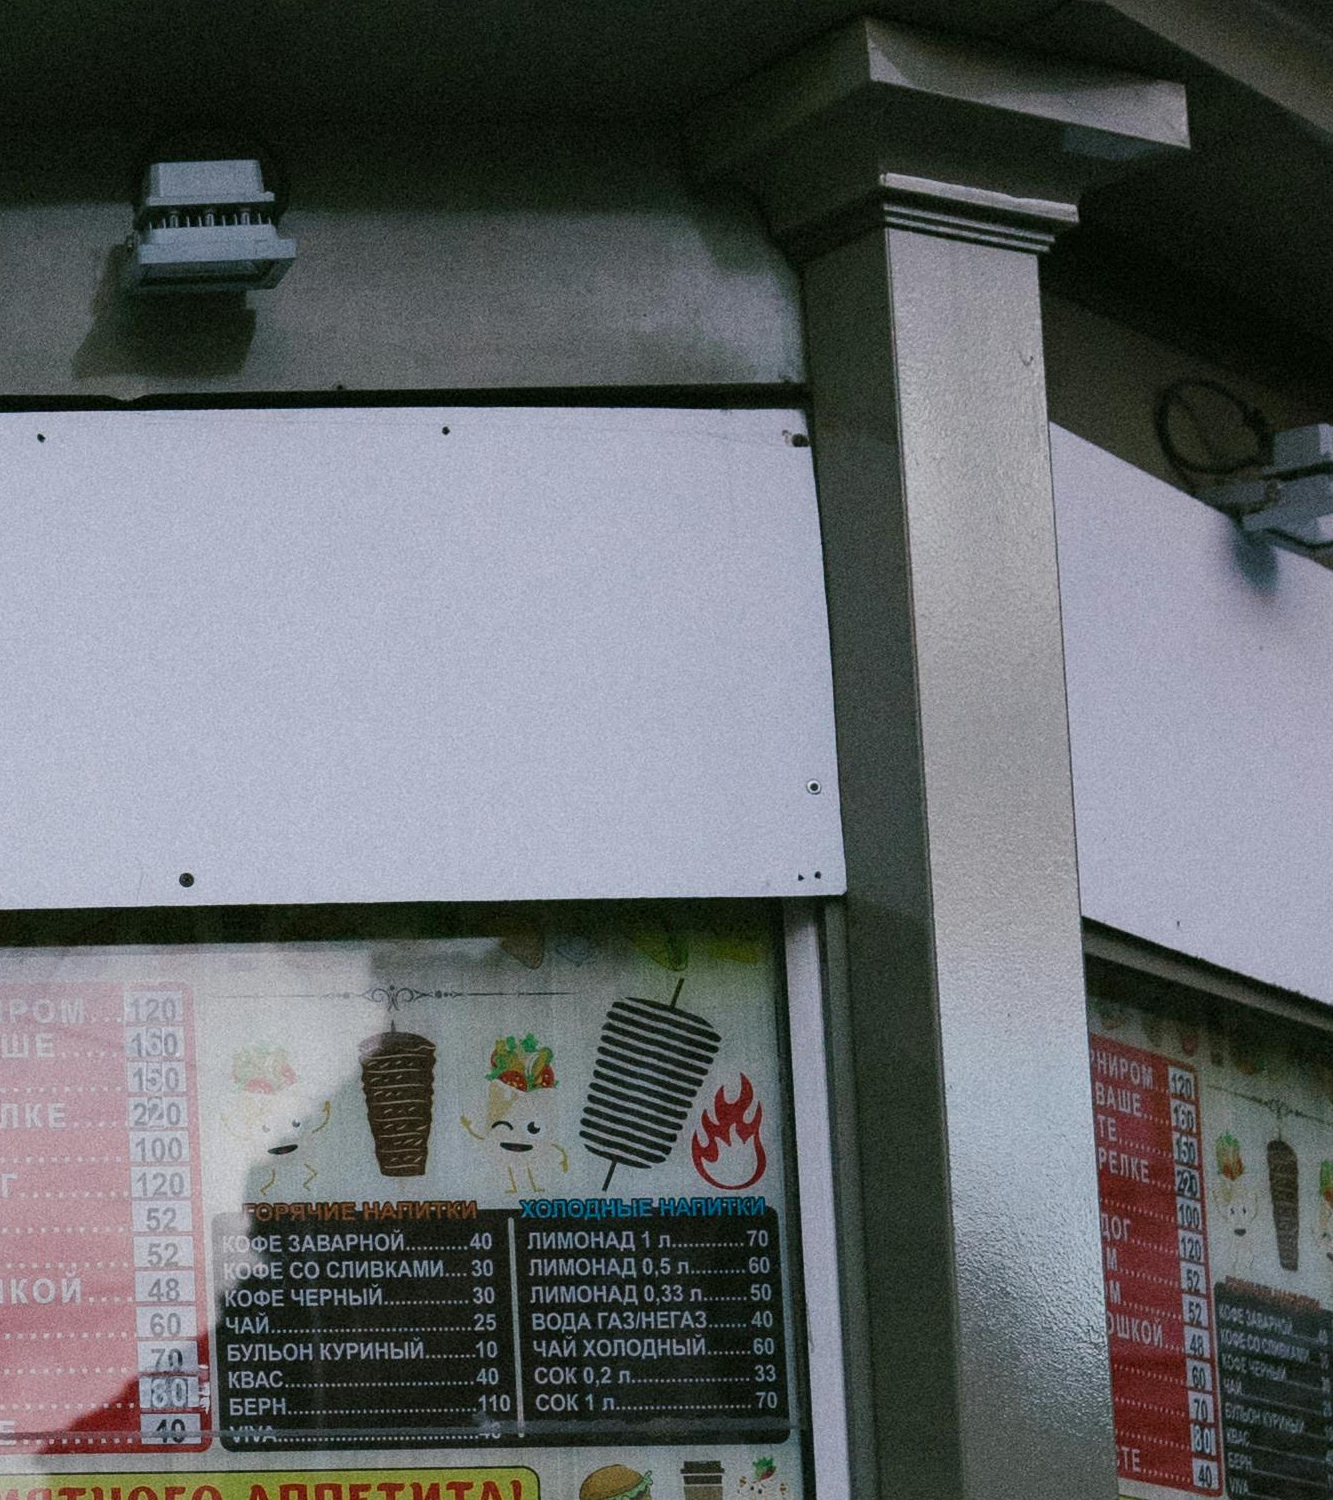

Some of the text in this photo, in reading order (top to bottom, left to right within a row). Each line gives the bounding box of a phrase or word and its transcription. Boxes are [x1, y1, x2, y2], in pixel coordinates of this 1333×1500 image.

[134, 1136, 182, 1161] 100
[136, 1171, 184, 1196] 120
[145, 1207, 177, 1231] 52
[244, 1197, 767, 1222] ГОРЯЧИЕ НАПИТКИ ХОЛОДНЫЕ НАПИТКИ
[223, 1229, 492, 1251] КОФЕ ЗАВАРНОЙ 40
[526, 1230, 768, 1251] ЛИМОНАД 1 л 70
[147, 1242, 179, 1266] 52
[224, 1260, 493, 1279] КОФЕ СО СЛИВКАМИ 30
[528, 1257, 770, 1278] ЛИМОНАД 0,5 л 60
[148, 1277, 180, 1301] 48
[225, 1283, 495, 1306] КОФЕ ЧЕРНЫЙ 30
[529, 1284, 771, 1306] ЛИМОНАД 0,33 л 50
[150, 1312, 181, 1337] 60
[225, 1312, 496, 1334] ЧАЙ 25
[531, 1311, 773, 1332] ВОДА ГАЗ/НЕГАЗ 40
[227, 1337, 497, 1361] БУЛЬОН КУРИНЫЙ 10
[532, 1334, 774, 1359] ЧАЙ ХОЛОДНЫЙ 60
[151, 1347, 182, 1372] 70
[228, 1368, 498, 1388] КВАС 40
[534, 1365, 776, 1386] СОК 0,2 л 33
[229, 1395, 510, 1415] БЕРН 110
[535, 1391, 777, 1411] СОК 1 л 70
[153, 1419, 186, 1443] 40
